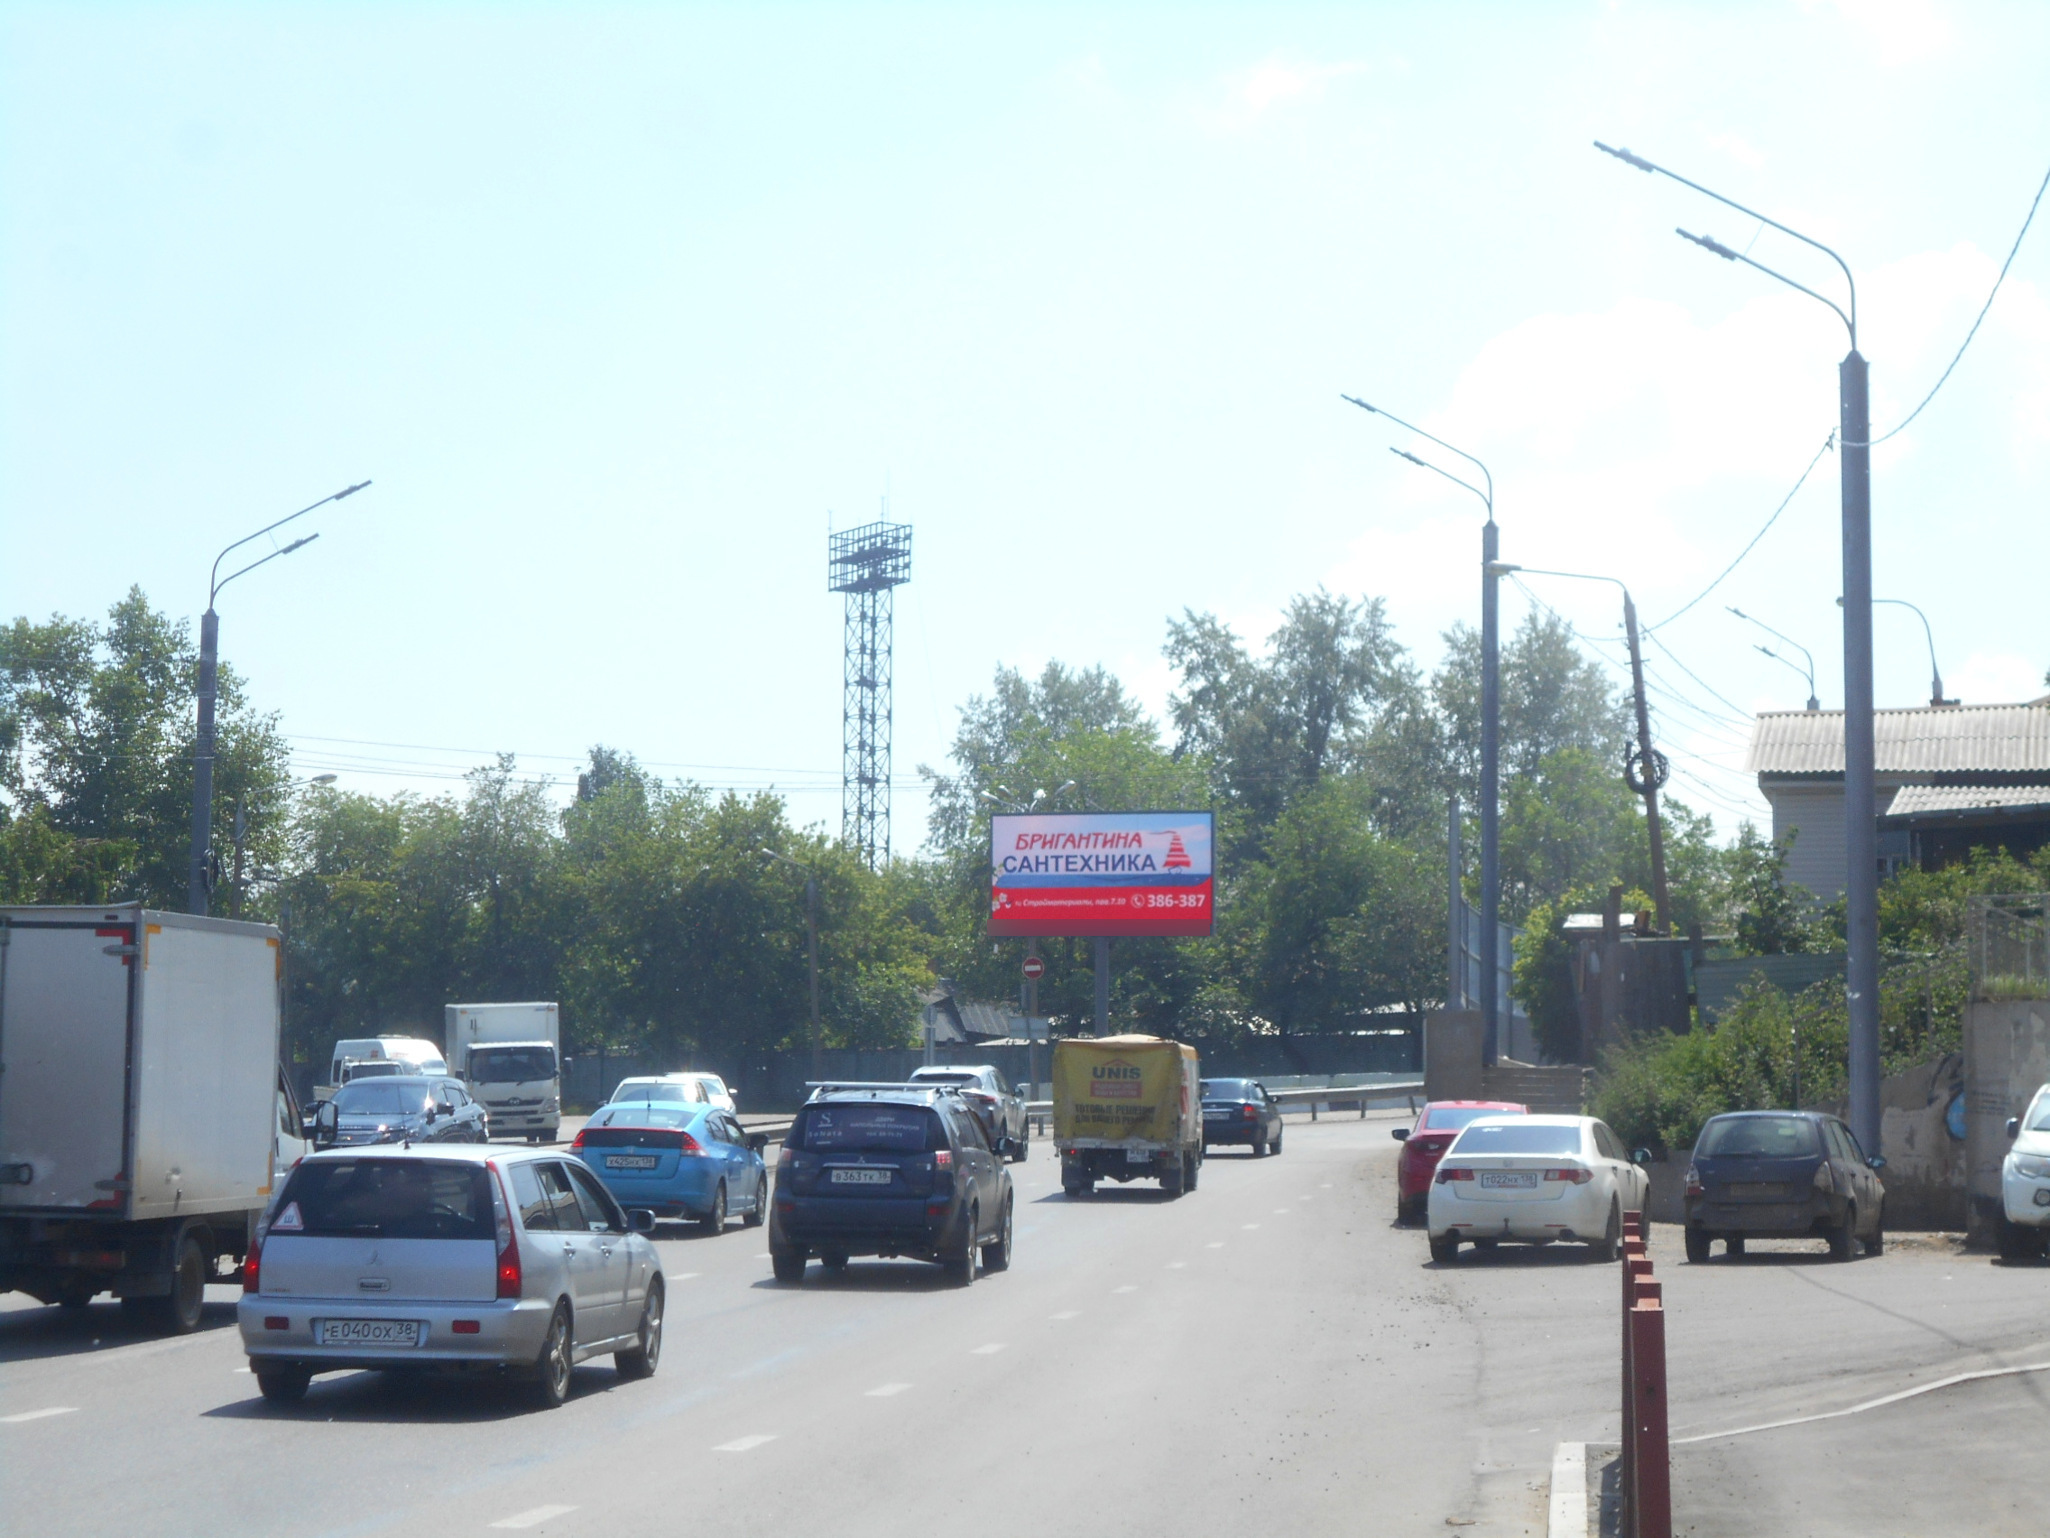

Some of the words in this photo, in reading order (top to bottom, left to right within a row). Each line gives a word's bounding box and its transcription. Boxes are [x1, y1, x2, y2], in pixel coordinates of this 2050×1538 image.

[1015, 832, 1143, 850] БРИГАНТИНА
[1003, 854, 1157, 873] САНТЕХНИКА
[1147, 894, 1206, 908] 386-387
[1092, 1066, 1141, 1079] UNIS
[283, 1214, 295, 1224] Ш
